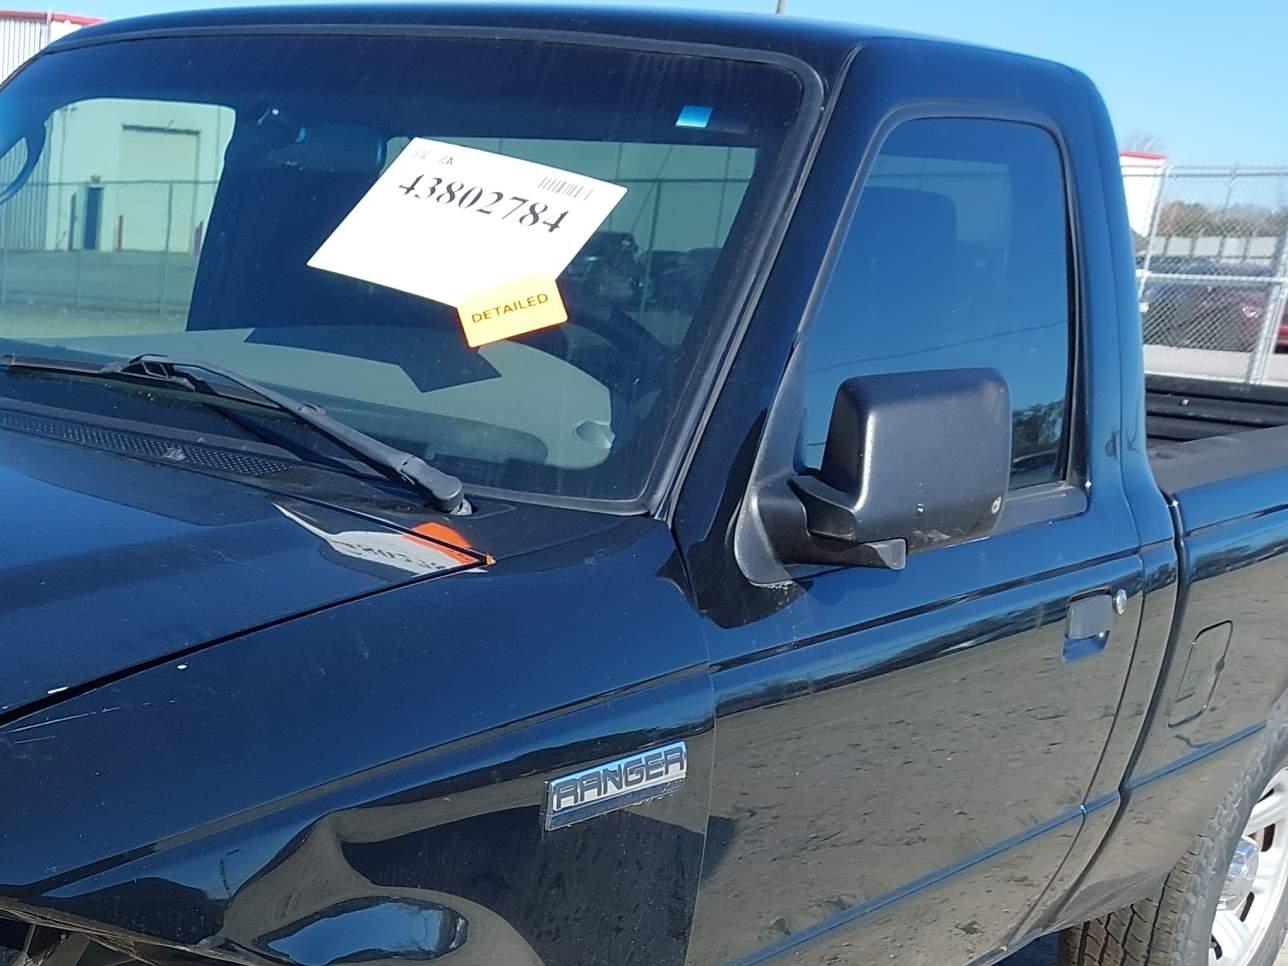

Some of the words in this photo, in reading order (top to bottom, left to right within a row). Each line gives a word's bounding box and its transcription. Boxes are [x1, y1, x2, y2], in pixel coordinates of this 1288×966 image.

[399, 174, 569, 233] 43802784
[471, 293, 549, 323] DETAILED
[554, 747, 685, 809] RANGER
